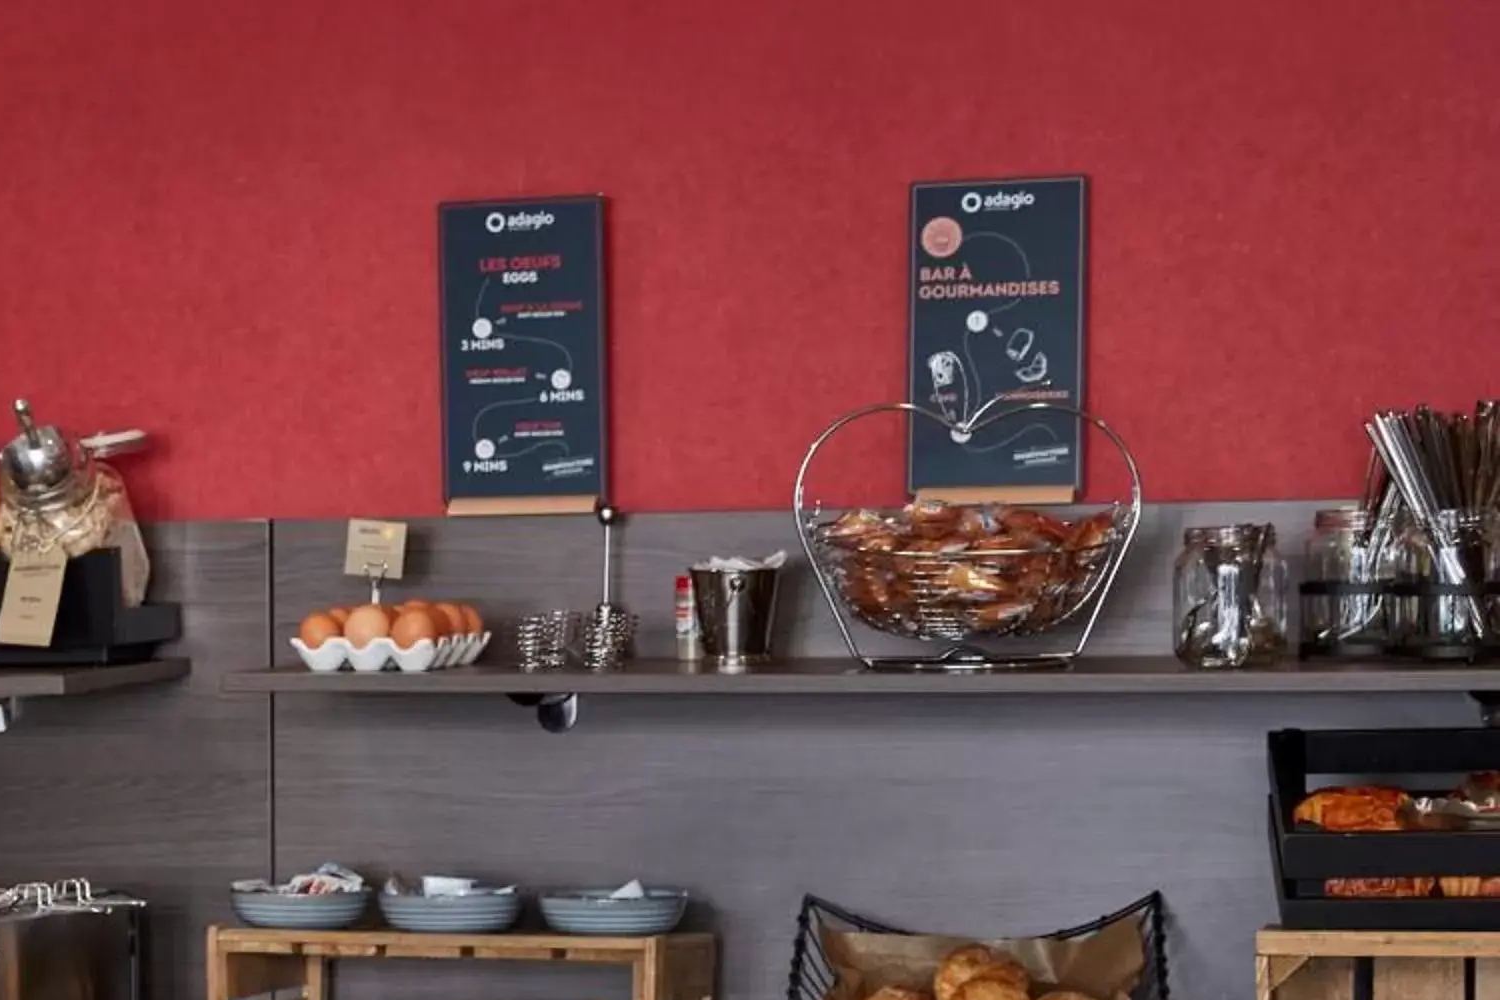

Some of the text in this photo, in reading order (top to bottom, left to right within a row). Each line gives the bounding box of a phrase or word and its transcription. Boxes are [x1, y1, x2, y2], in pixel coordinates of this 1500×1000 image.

[983, 191, 1035, 211] adagio
[507, 210, 555, 230] adagio
[480, 254, 561, 273] LES OEUFS
[920, 261, 972, 281] BAR À
[502, 271, 538, 285] EGGS
[919, 281, 1060, 299] GOURMANDISES
[471, 338, 505, 351] MINS
[549, 389, 584, 402] MINS
[474, 460, 508, 473] MINS
